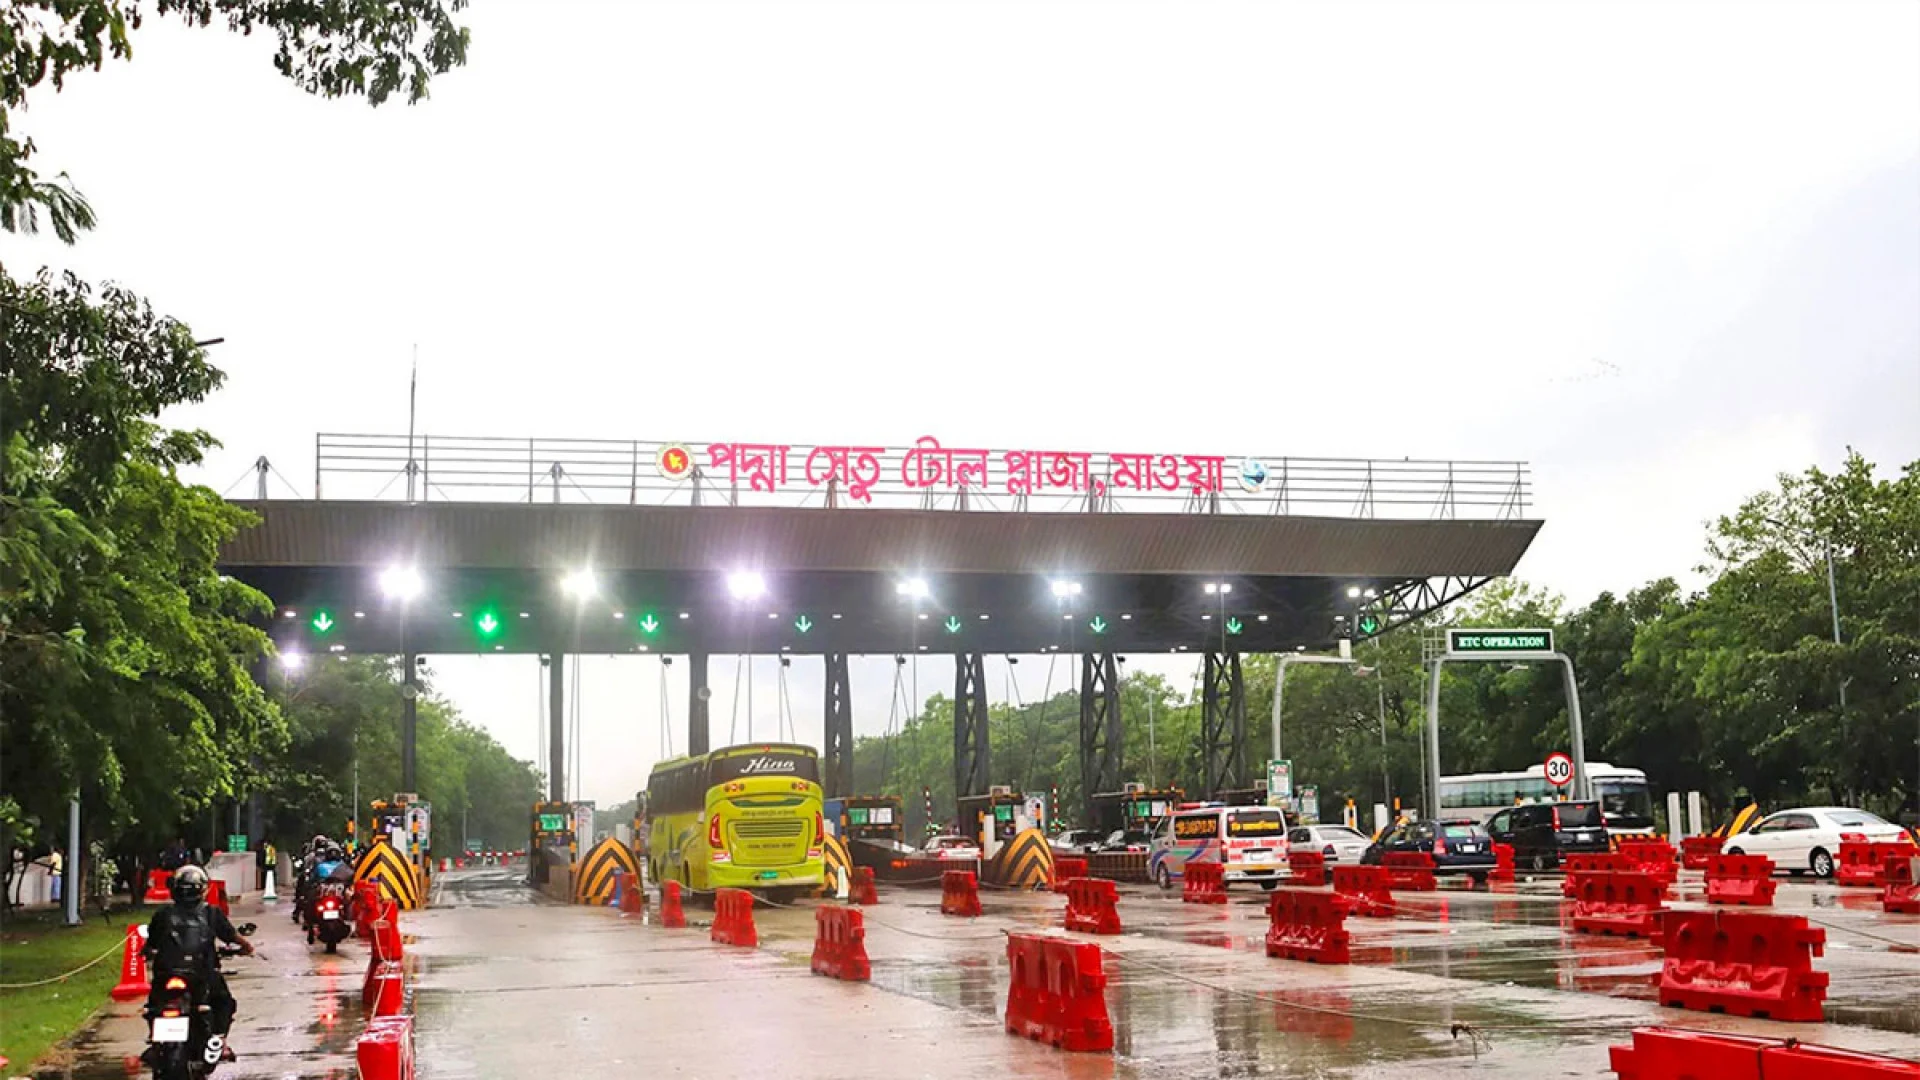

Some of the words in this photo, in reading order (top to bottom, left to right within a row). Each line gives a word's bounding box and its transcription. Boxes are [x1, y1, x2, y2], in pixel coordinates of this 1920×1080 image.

[708, 444, 790, 492] পদ্মা
[806, 446, 884, 502] সেতু
[902, 436, 989, 487] টোল
[1110, 453, 1224, 495] মাওয়া
[1458, 636, 1480, 648] ETC
[1482, 636, 1545, 648] OPERATION
[1549, 761, 1569, 777] 30
